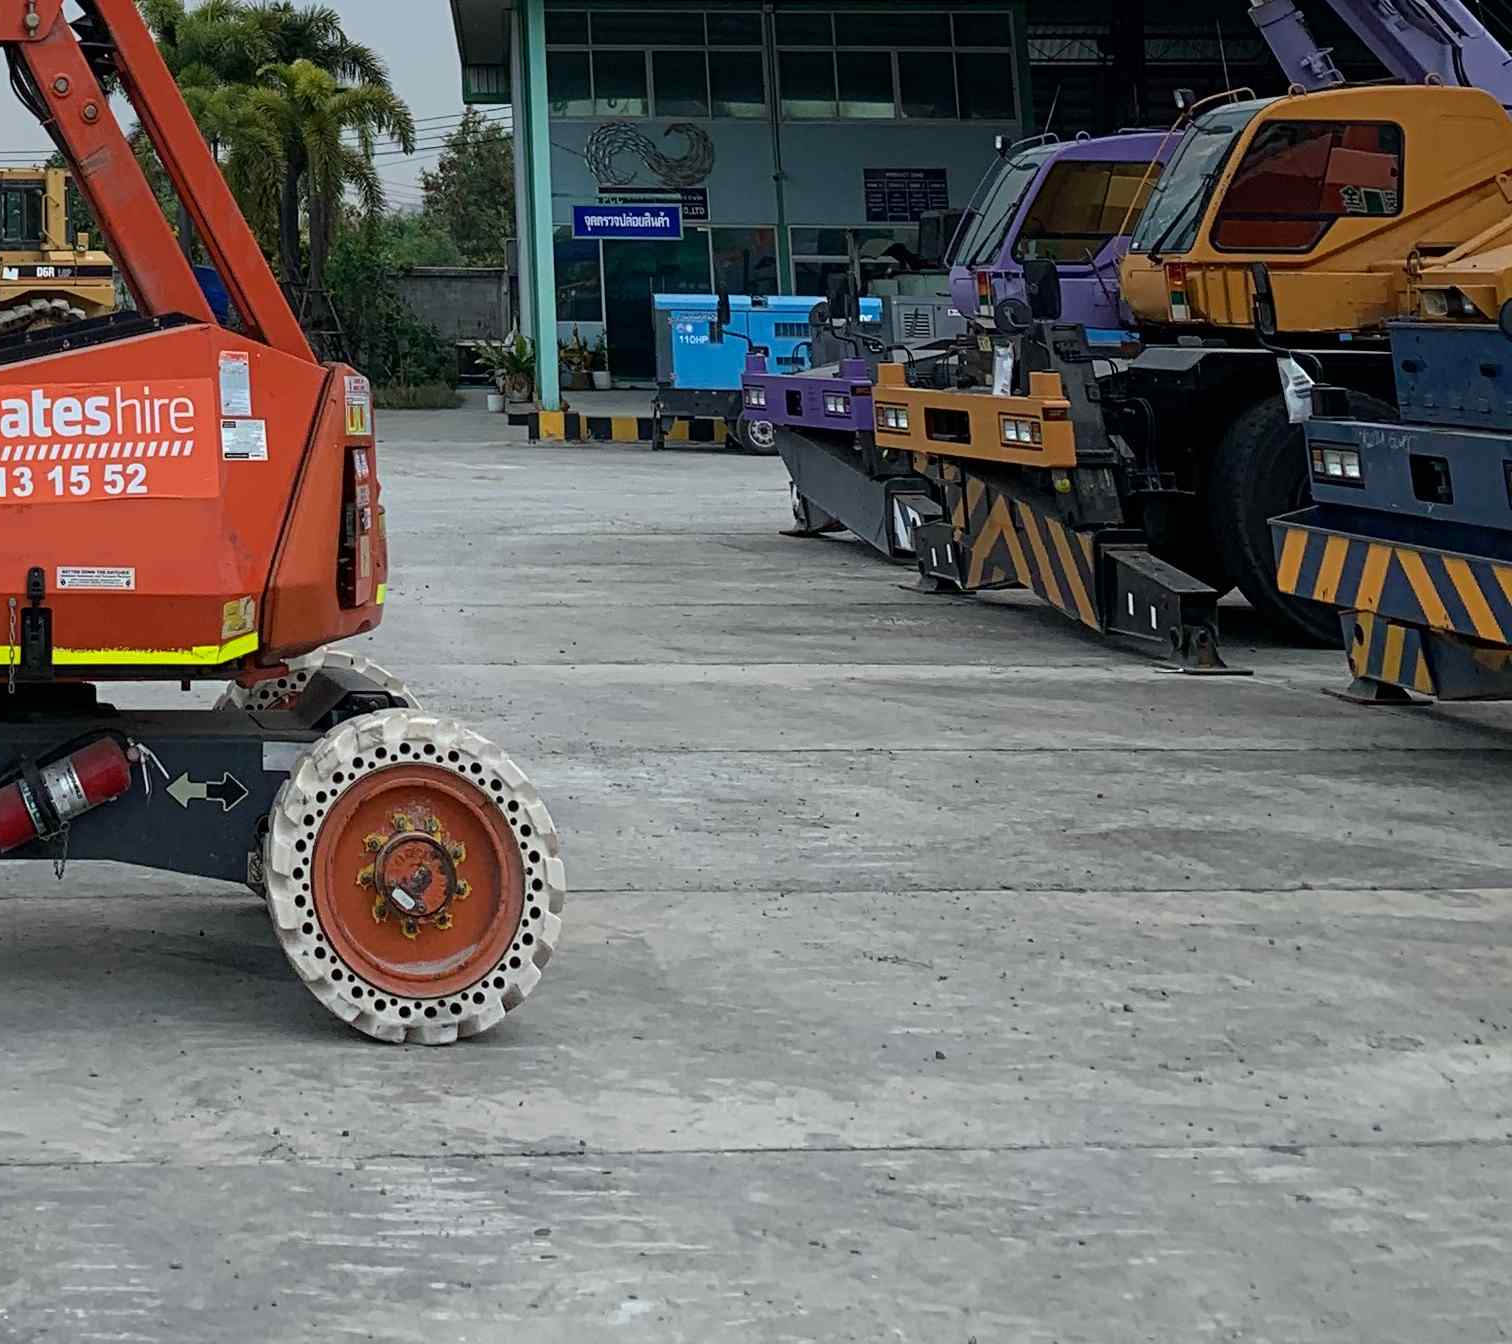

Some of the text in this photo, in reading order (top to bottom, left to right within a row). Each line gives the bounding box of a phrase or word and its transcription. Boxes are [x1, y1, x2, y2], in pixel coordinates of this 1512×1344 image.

[36, 267, 55, 278] D6R
[47, 464, 90, 496] 15
[103, 463, 148, 495] 52
